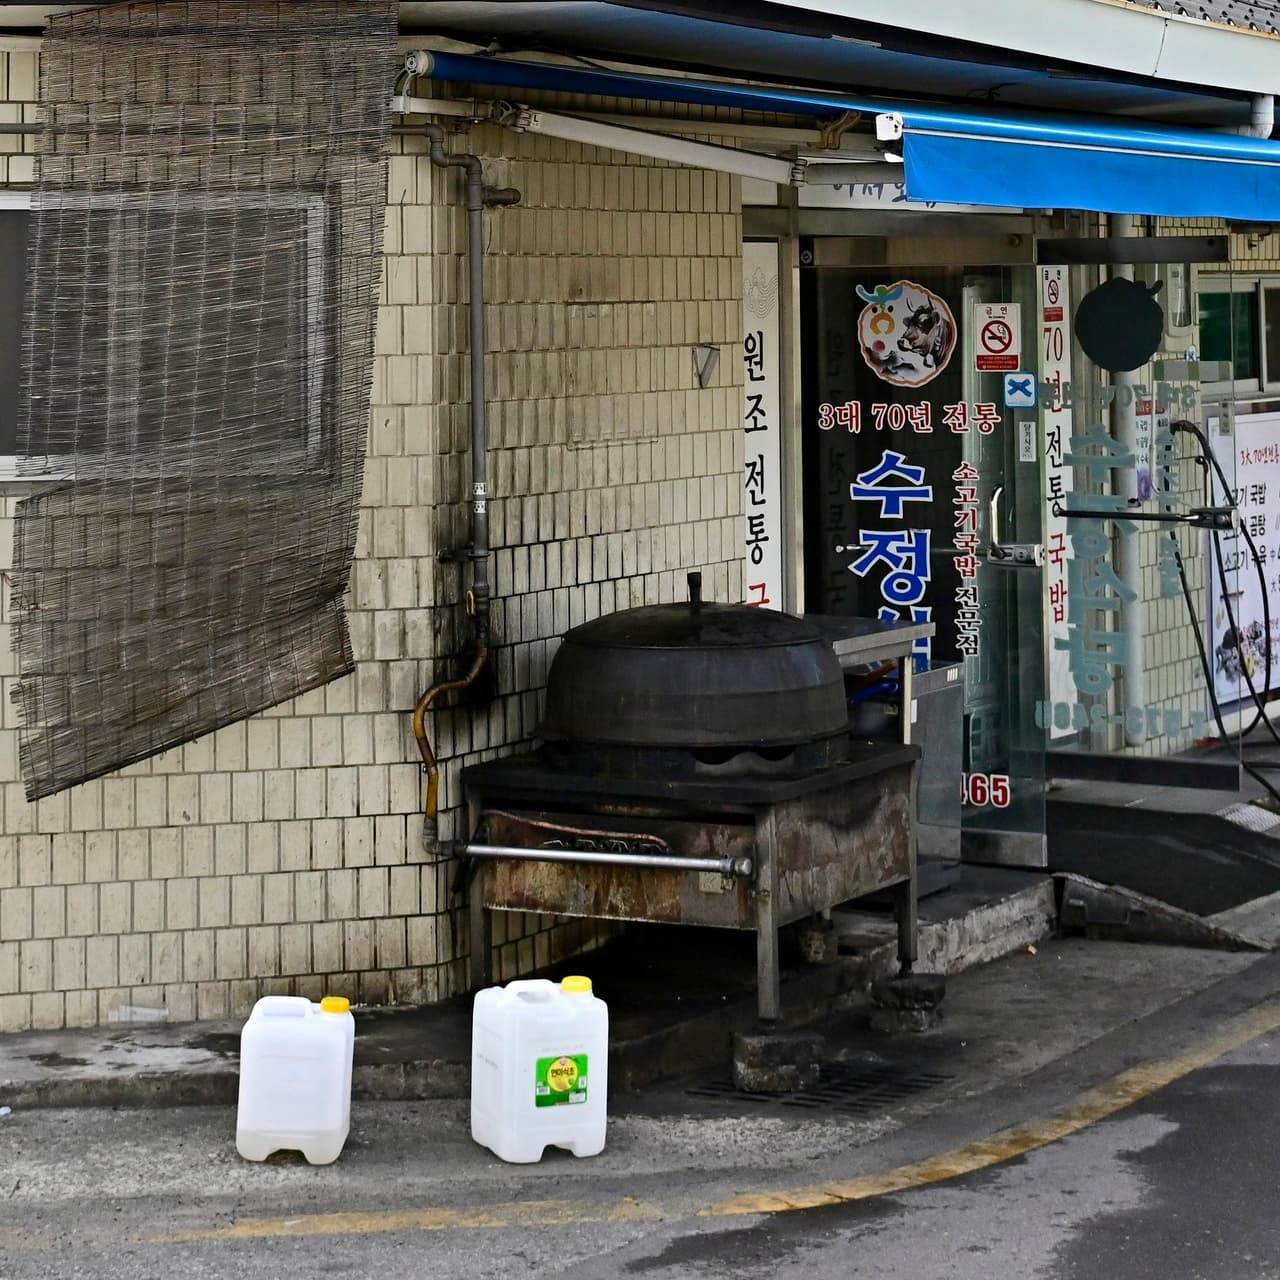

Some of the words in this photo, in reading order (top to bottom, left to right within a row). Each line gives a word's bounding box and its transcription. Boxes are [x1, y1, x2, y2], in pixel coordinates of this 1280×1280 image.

[743, 331, 768, 434] 원조
[818, 401, 861, 433] 3대
[871, 401, 933, 433] 70년
[942, 401, 1002, 435] 전통
[745, 454, 770, 565] 전통
[952, 461, 981, 579] 소고기국밥
[955, 585, 982, 657] 전문점
[1048, 533, 1067, 624] 국밥
